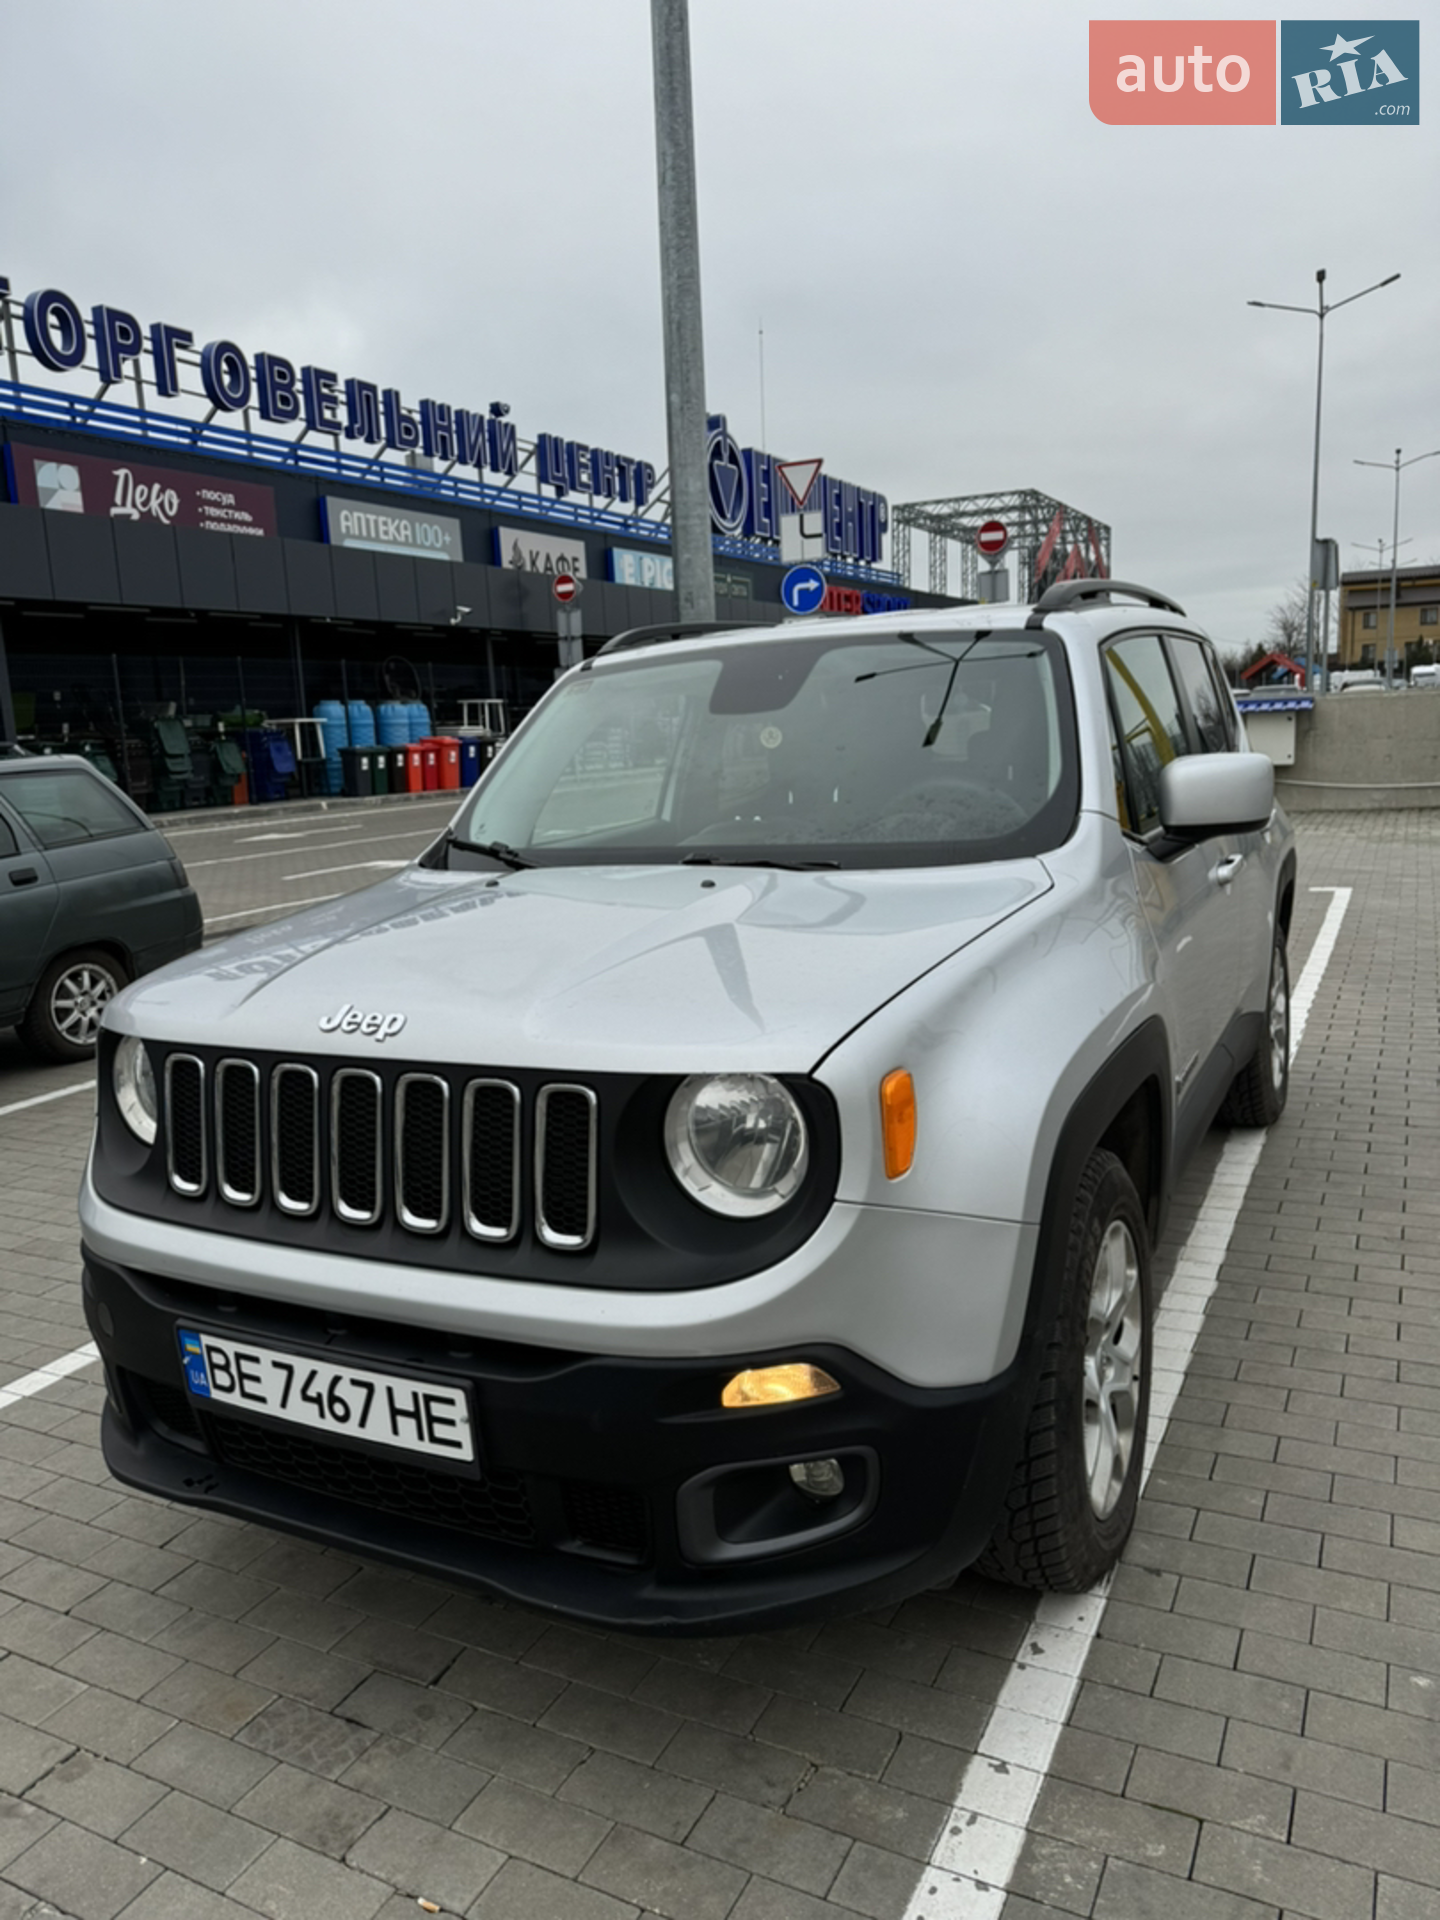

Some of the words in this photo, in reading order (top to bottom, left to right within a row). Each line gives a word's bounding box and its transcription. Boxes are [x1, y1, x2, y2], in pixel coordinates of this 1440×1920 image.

[0, 275, 518, 476] ОРГОВЕЛЬНИЙ
[535, 433, 656, 507] ЦЕНТР
[109, 467, 181, 525] Деко
[339, 510, 413, 543] АПТЕКА
[415, 522, 452, 548] 100+
[529, 549, 581, 576] КАФЕ
[319, 1003, 407, 1043] Jeep
[204, 1343, 268, 1405] BE
[271, 1360, 376, 1430] 7467
[386, 1385, 463, 1450] HE
